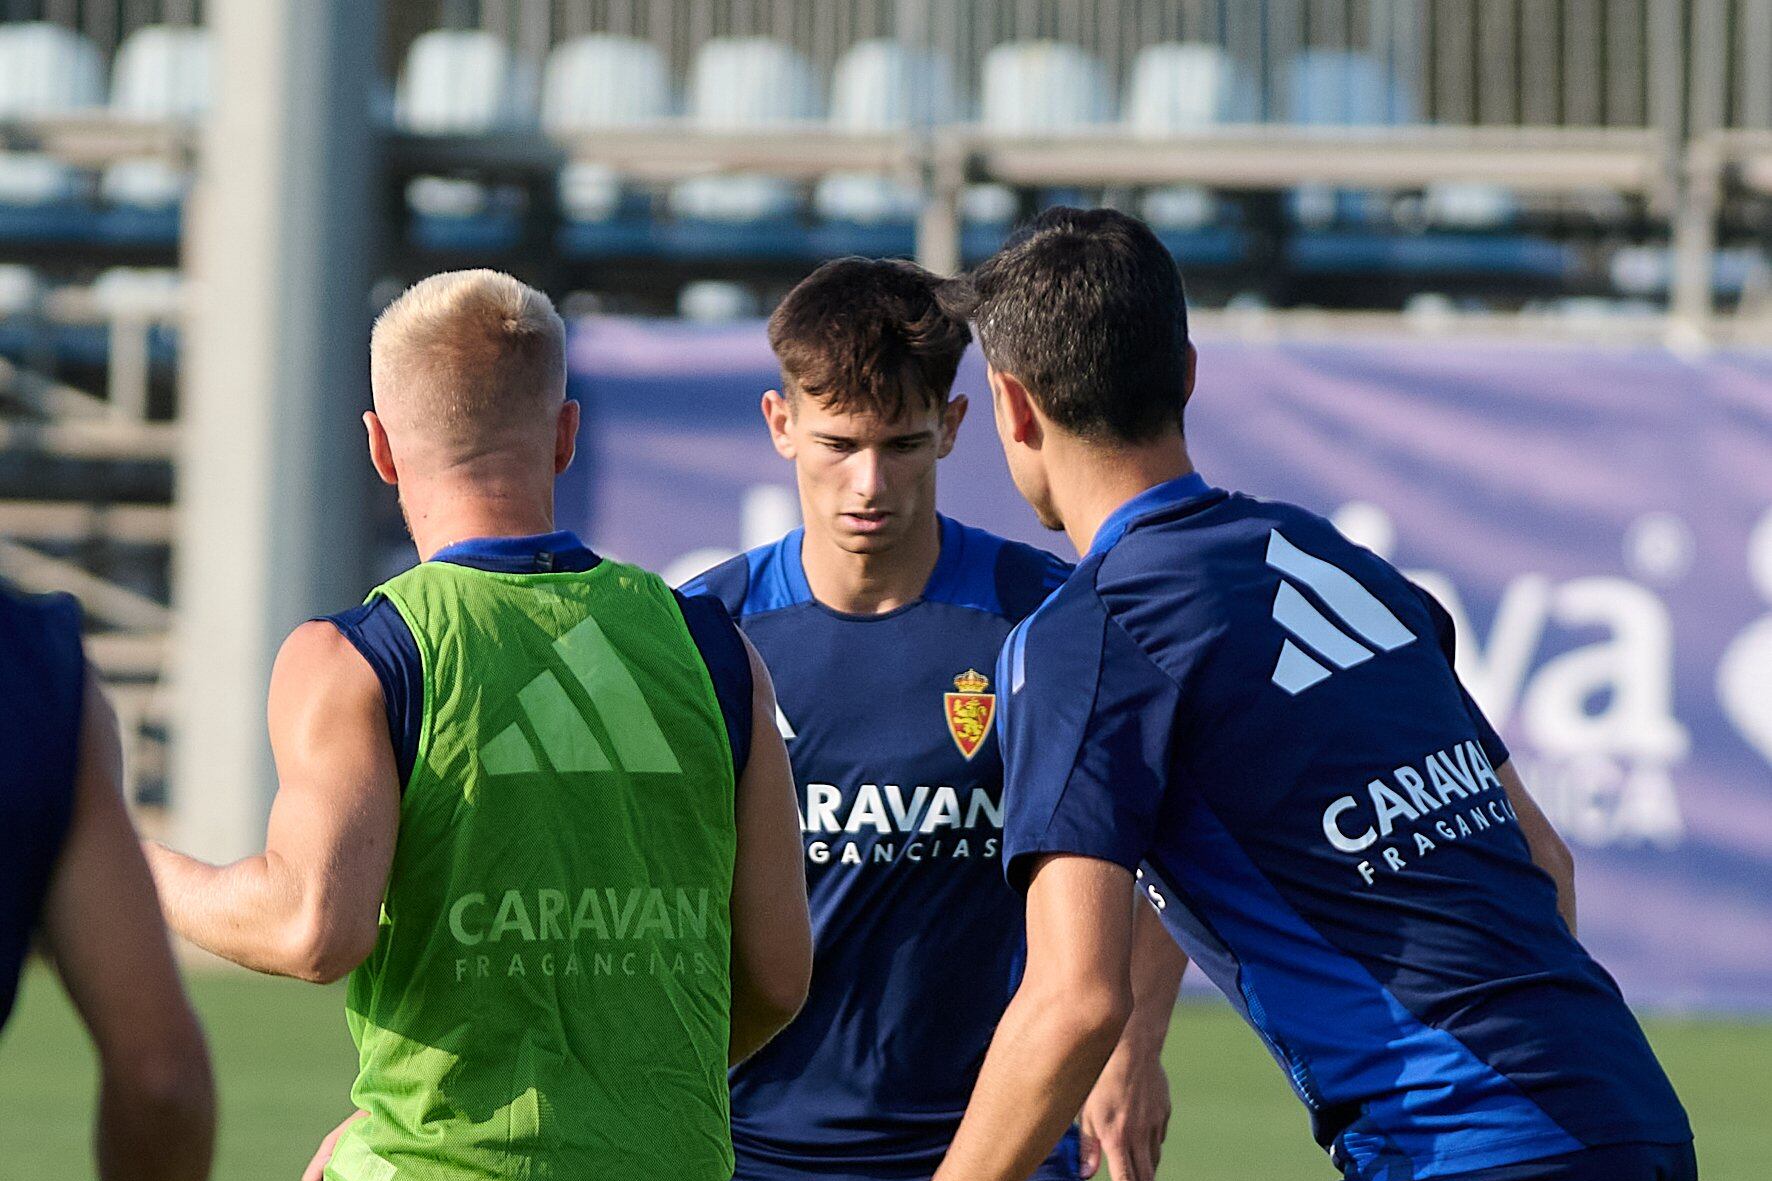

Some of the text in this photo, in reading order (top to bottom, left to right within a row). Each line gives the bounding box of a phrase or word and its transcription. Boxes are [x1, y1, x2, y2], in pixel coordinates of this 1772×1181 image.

[800, 783, 1004, 833] RAVAN
[1322, 740, 1502, 852] CARAVA
[448, 887, 709, 946] CARAVAN
[455, 952, 707, 982] FRAGANCIAS
